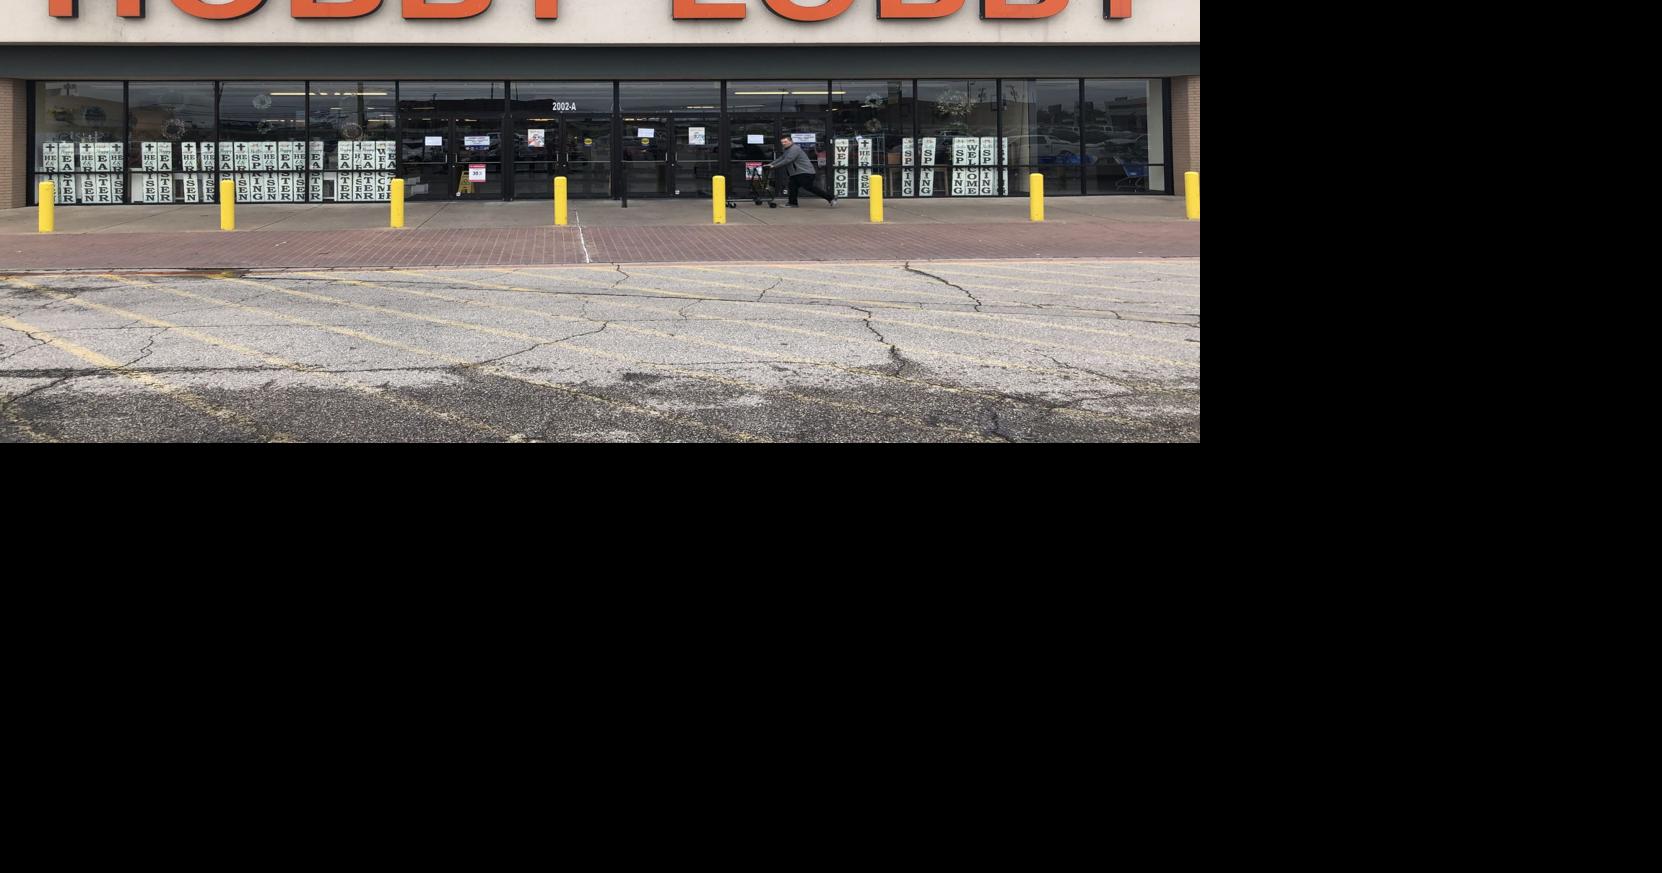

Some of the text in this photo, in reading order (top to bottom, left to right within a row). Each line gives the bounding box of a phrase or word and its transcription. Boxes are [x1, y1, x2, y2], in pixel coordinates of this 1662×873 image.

[552, 101, 577, 111] 2002-A
[62, 155, 74, 202] EASTER
[97, 155, 110, 202] EASTER
[160, 155, 170, 201] EASTER
[280, 154, 291, 201] EASTER
[311, 153, 321, 200] EASTER
[340, 153, 351, 200] EASTER
[363, 153, 374, 200] EASTER
[835, 146, 848, 196] WELCOME
[966, 144, 978, 195] WELCOME
